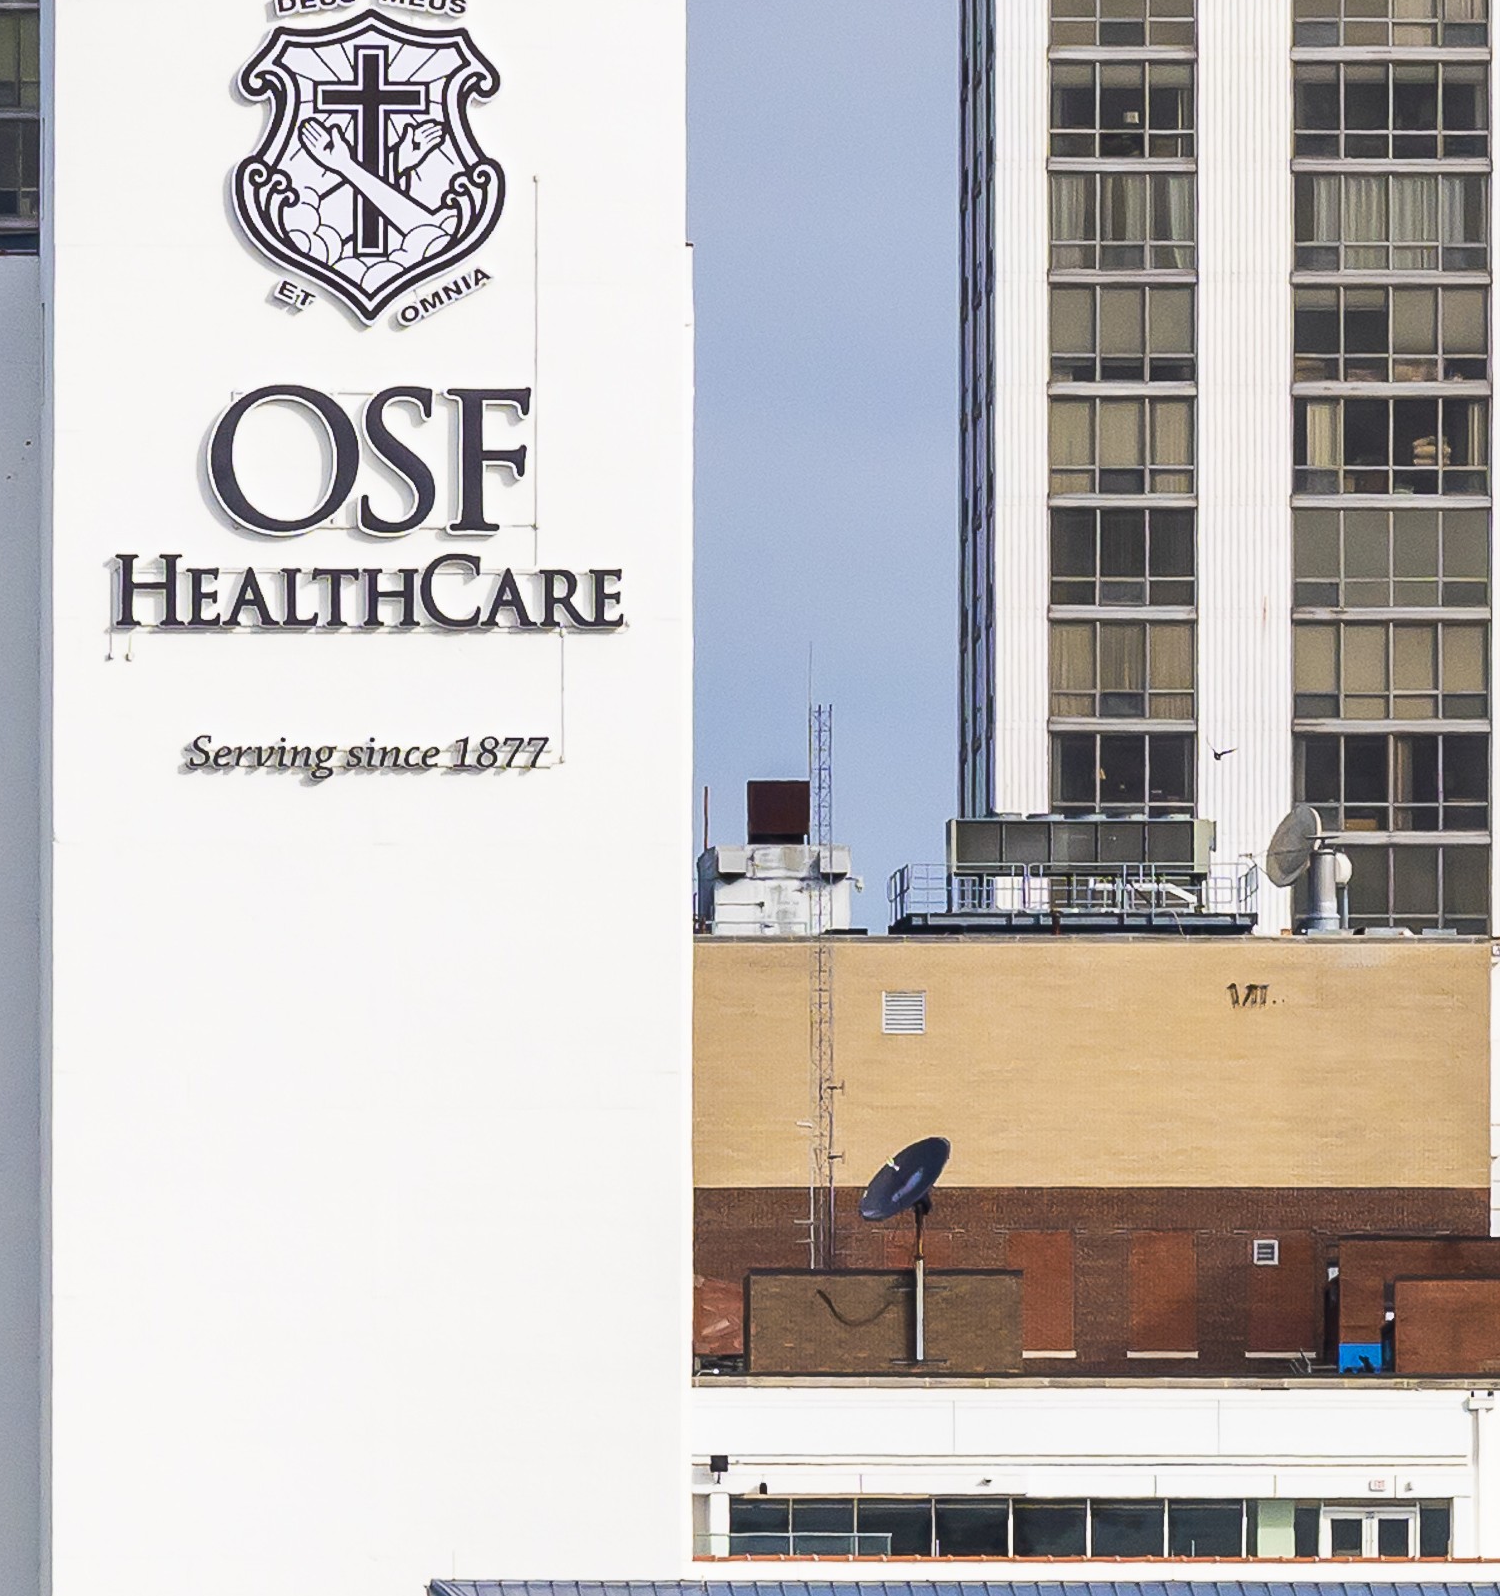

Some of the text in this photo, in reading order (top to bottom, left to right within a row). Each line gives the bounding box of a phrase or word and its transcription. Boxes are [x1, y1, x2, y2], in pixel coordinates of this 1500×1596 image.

[278, 268, 491, 323] ET OMNIA
[210, 385, 531, 533] OSF
[189, 735, 550, 780] Serving since 1877
